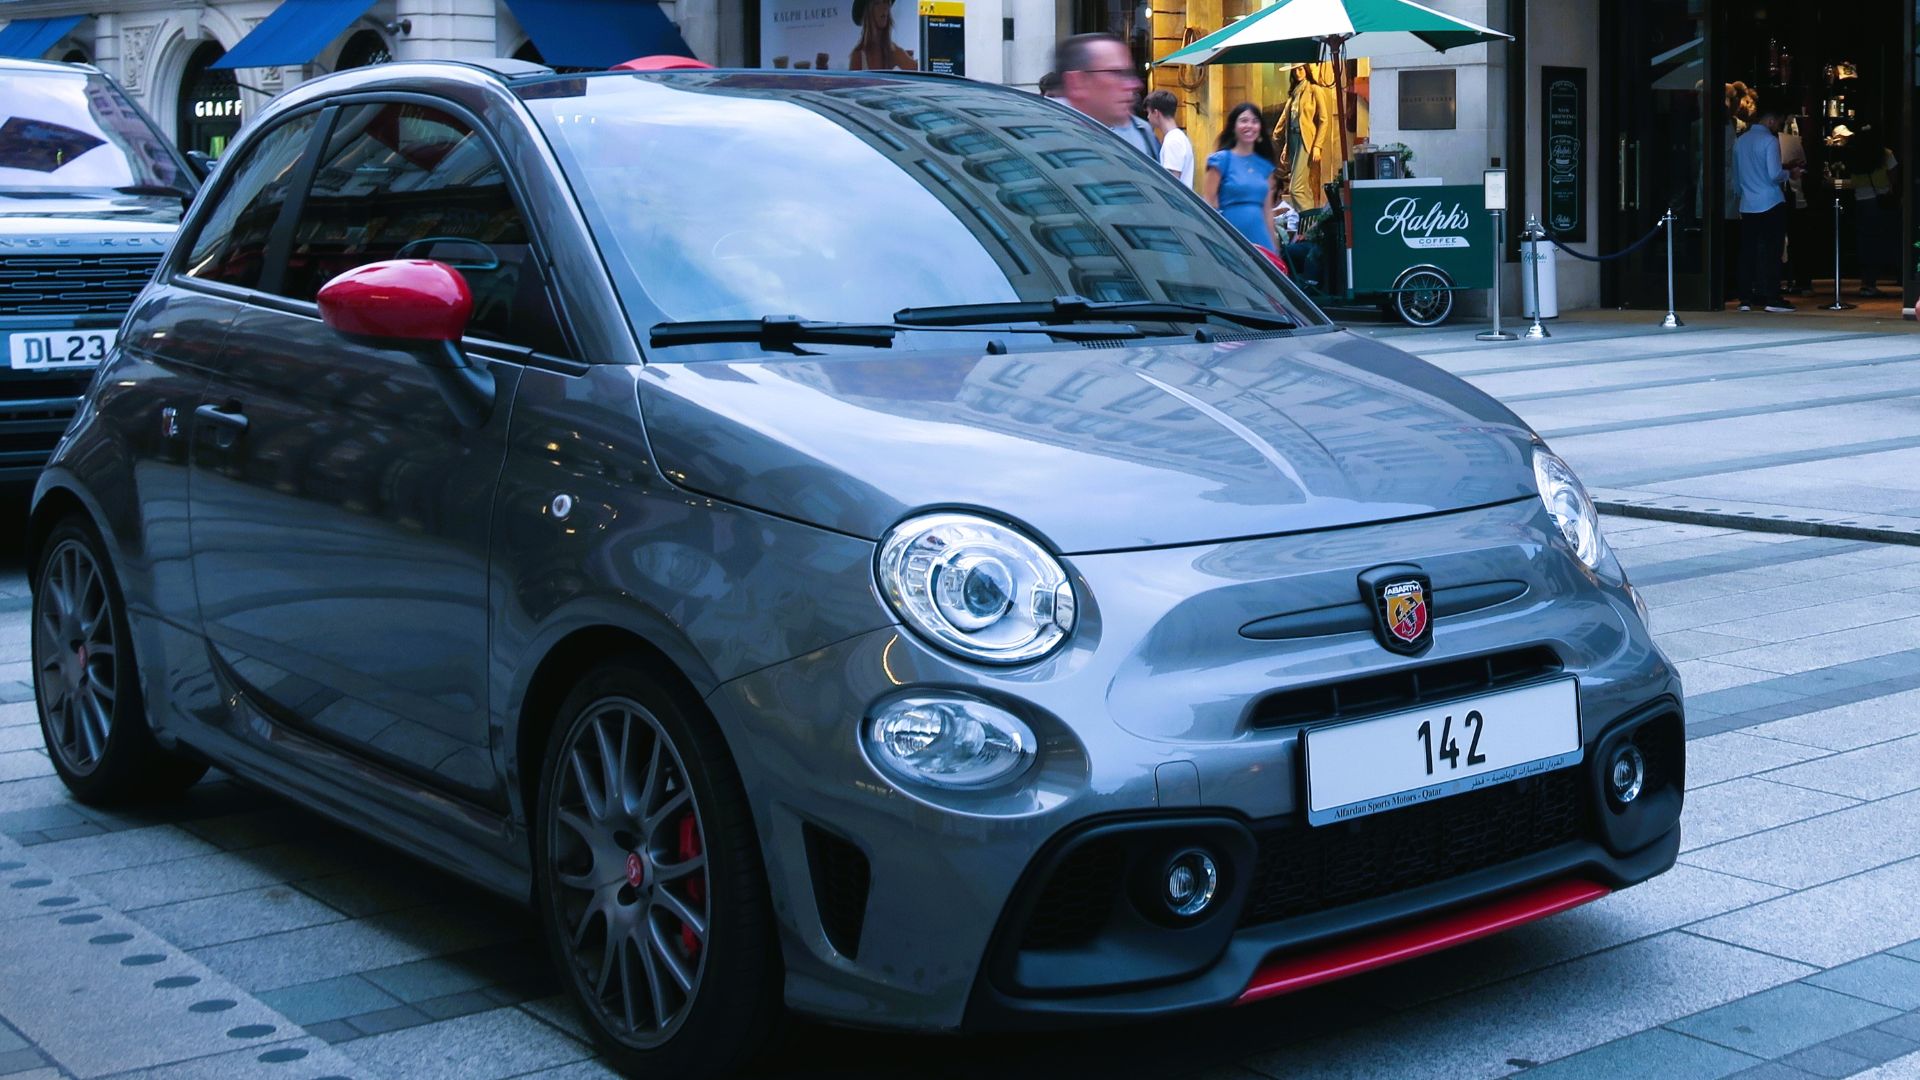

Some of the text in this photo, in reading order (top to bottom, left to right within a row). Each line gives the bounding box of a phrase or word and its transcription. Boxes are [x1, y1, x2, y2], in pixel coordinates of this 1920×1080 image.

[195, 99, 243, 118] GRAFF
[1375, 196, 1469, 237] Ralph's
[1418, 237, 1457, 245] COFFEE
[24, 335, 106, 364] DL23
[1387, 584, 1420, 595] ABARTH
[1418, 710, 1486, 775] 142
[1334, 804, 1367, 819] Alfardan
[1367, 799, 1391, 814] Sports
[1391, 794, 1417, 806] Motors
[1422, 788, 1442, 799] Qatar
